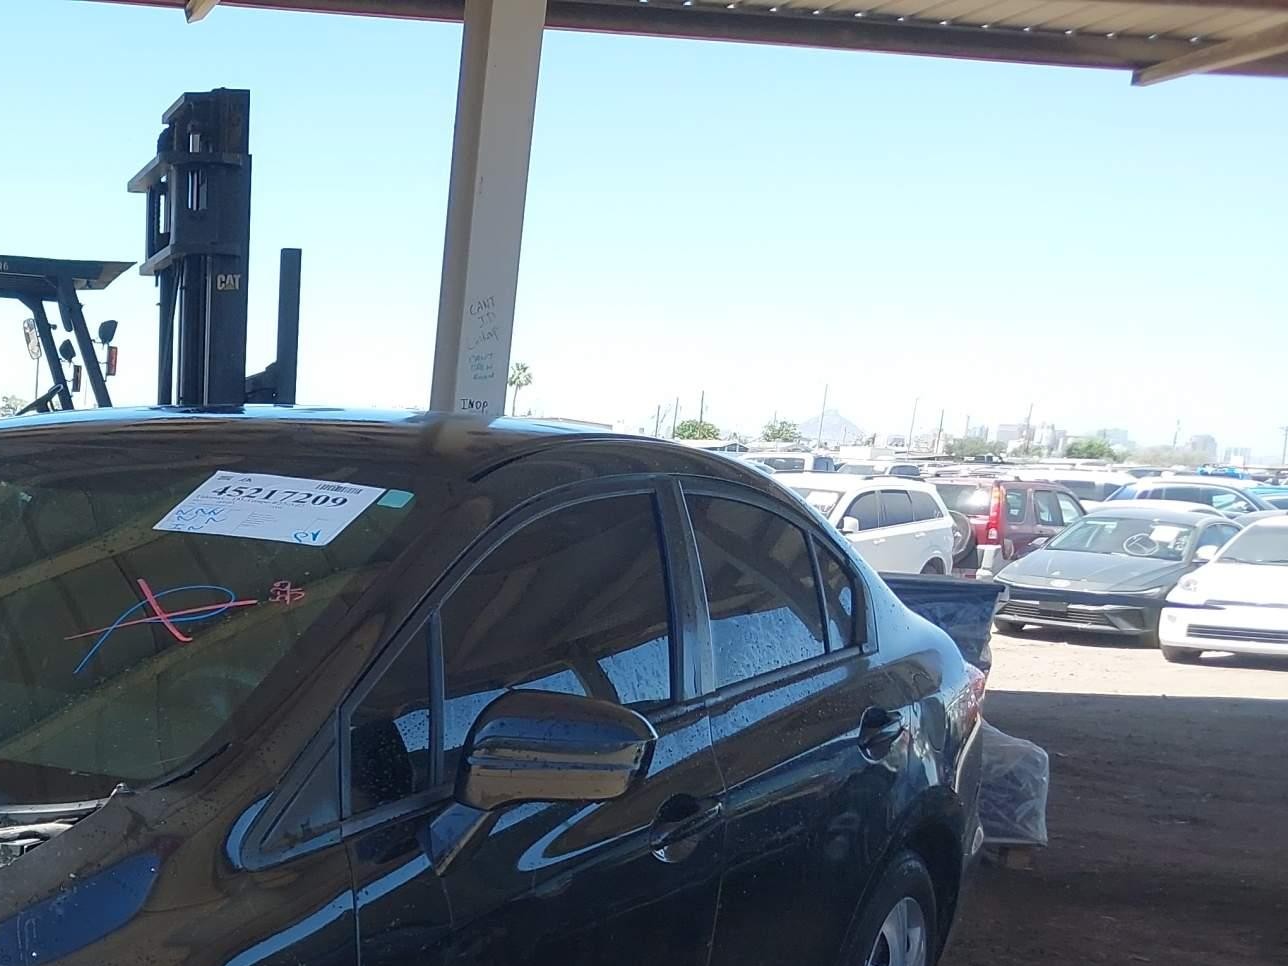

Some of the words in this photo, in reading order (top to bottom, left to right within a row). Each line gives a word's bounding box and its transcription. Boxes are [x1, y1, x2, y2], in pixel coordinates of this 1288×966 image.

[216, 274, 241, 290] CAT
[461, 399, 488, 413] INOP
[213, 484, 348, 508] 45217209
